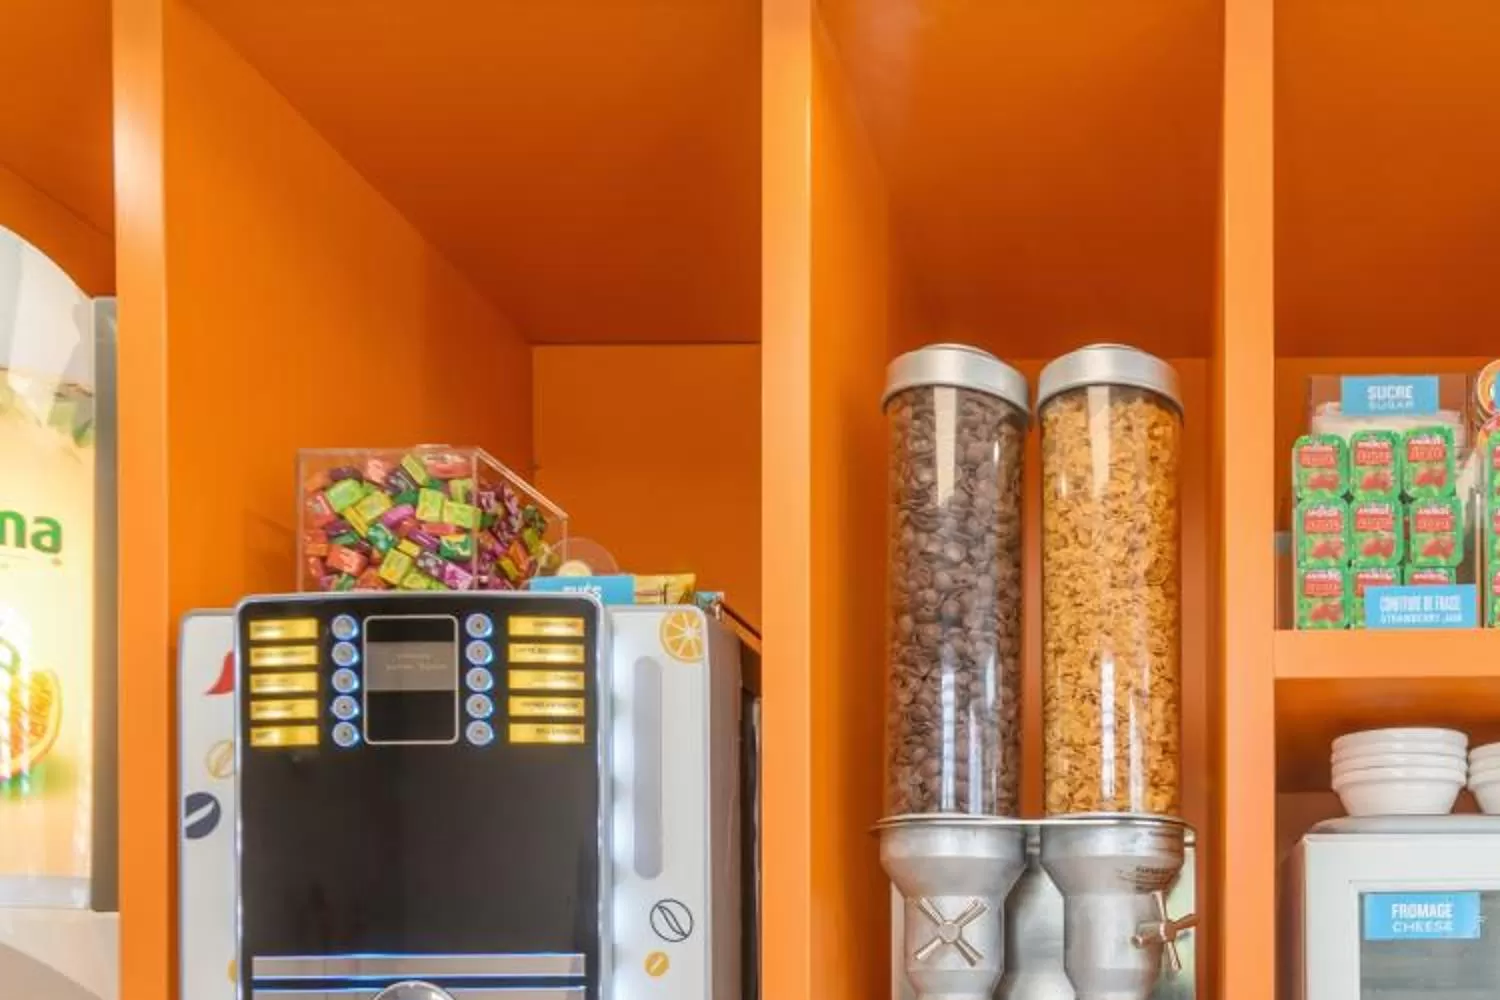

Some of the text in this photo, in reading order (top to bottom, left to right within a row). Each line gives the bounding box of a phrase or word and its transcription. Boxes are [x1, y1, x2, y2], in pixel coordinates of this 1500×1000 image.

[1367, 384, 1413, 399] SUCRE
[1392, 903, 1453, 919] FROMAGE
[1392, 920, 1454, 933] CHEESE
